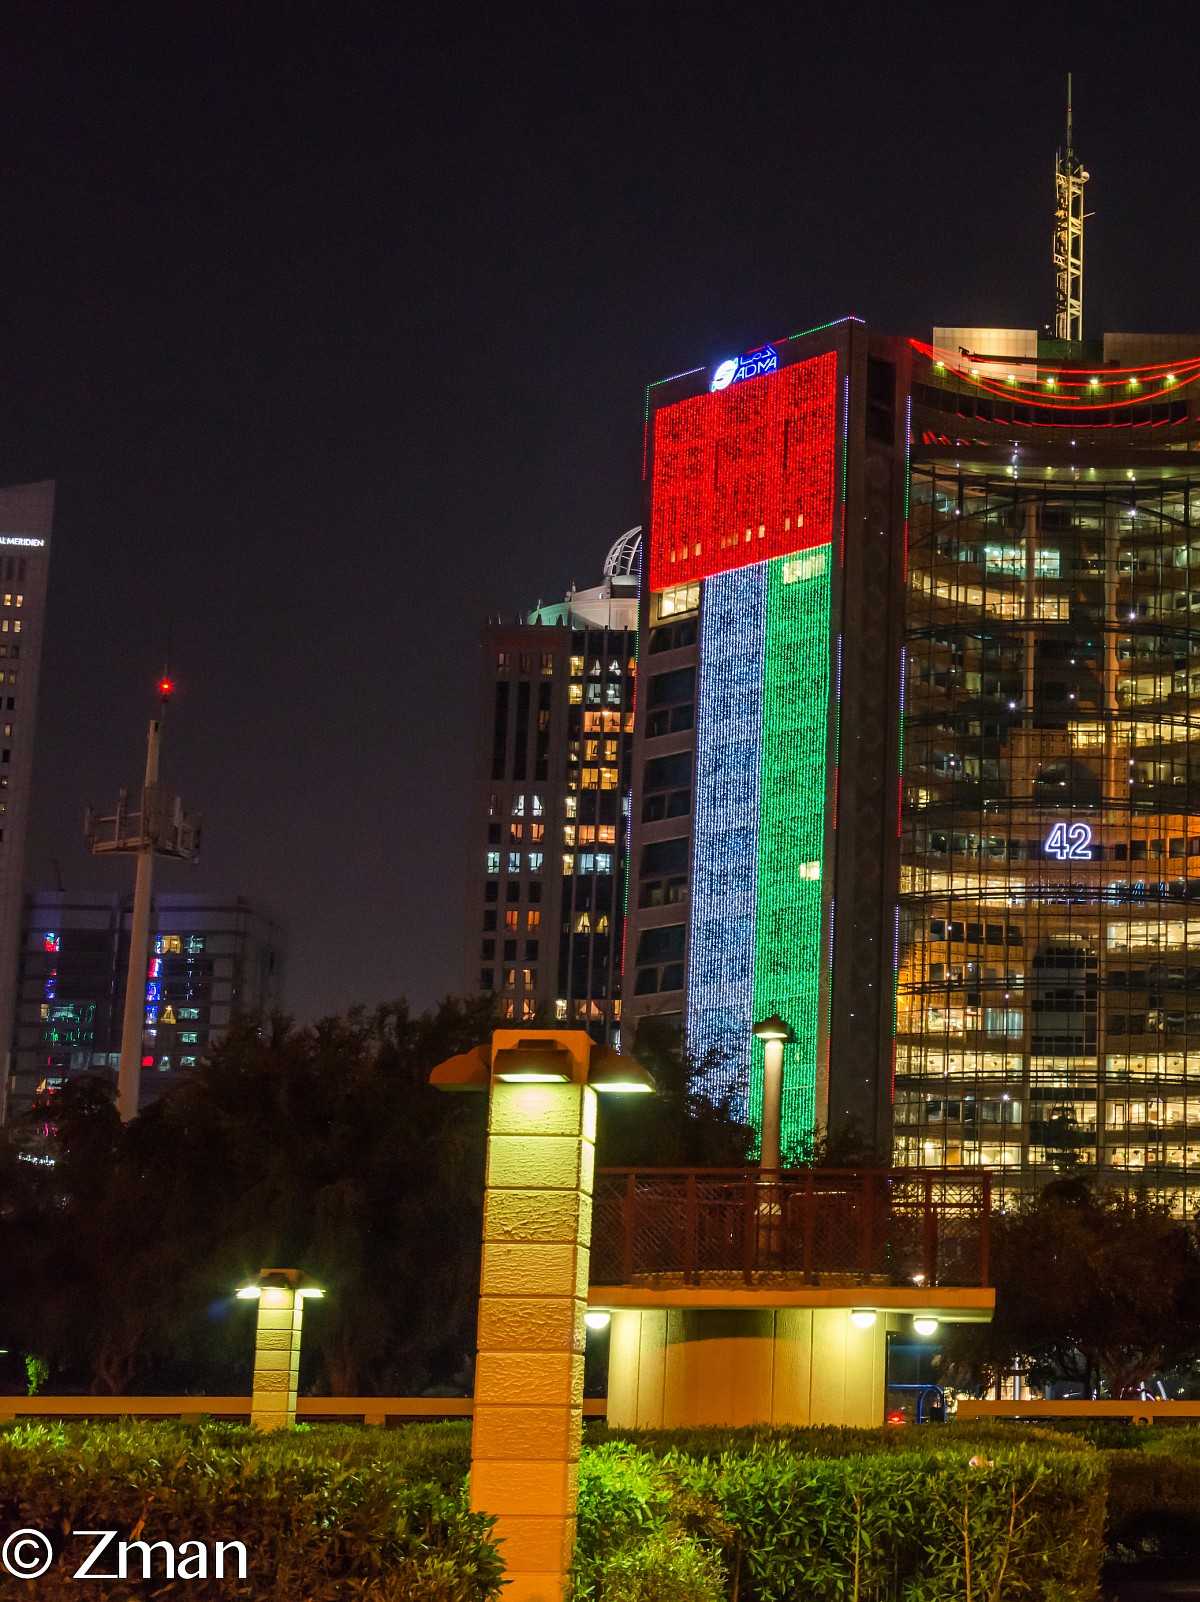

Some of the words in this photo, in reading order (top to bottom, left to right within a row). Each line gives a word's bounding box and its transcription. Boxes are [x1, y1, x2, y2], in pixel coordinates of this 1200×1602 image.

[732, 355, 778, 383] ADMA
[7, 537, 45, 547] MERIDIEN
[1044, 822, 1092, 860] 42
